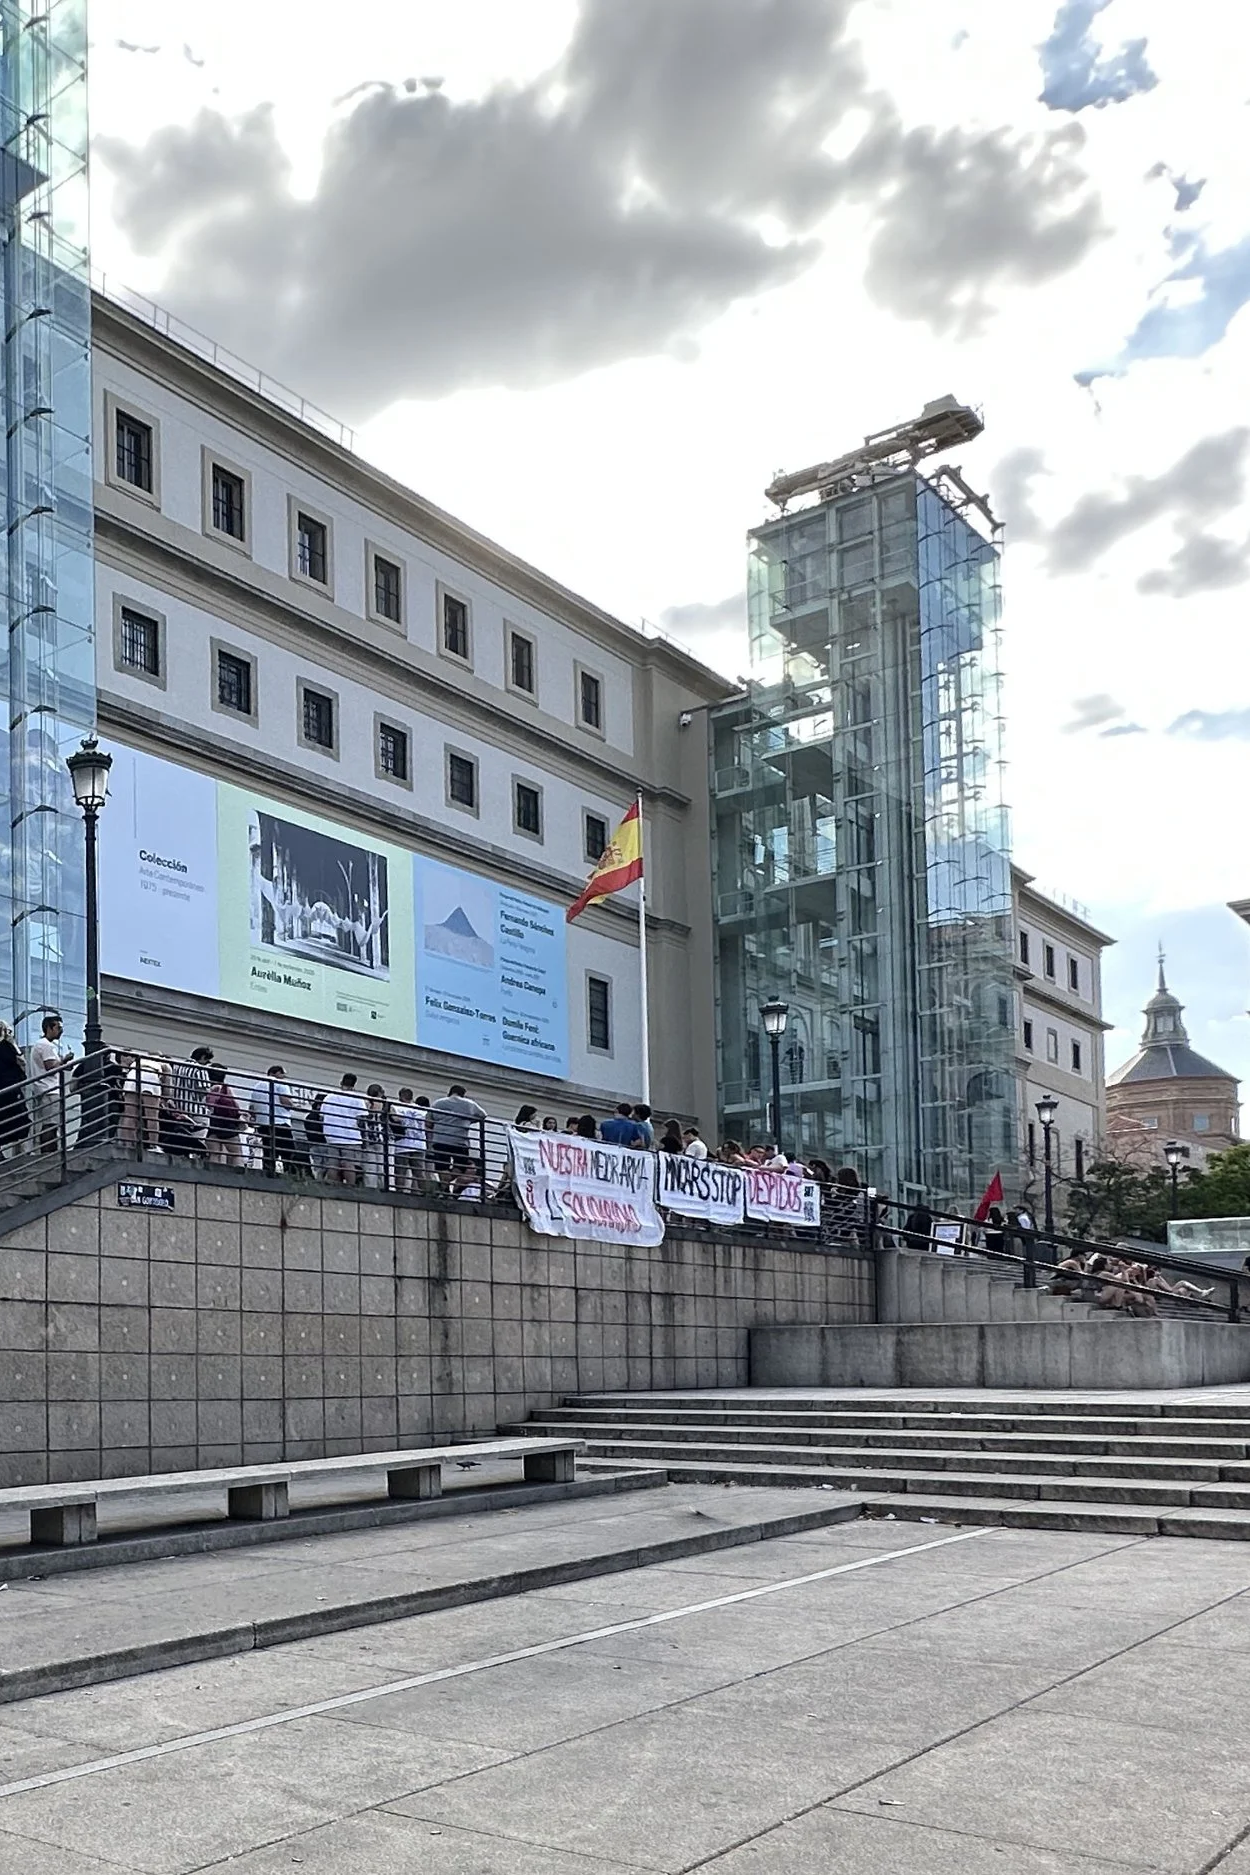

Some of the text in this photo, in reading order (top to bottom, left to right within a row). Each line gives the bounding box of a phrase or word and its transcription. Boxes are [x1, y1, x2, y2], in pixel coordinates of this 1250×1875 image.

[139, 850, 188, 873] Colección
[500, 910, 528, 927] Fernando
[282, 974, 312, 991] Muñoz
[501, 975, 523, 989] Andrea
[539, 1139, 589, 1178] NUESTRA
[619, 1155, 649, 1194] ARMA
[711, 1168, 742, 1207] STOP
[747, 1170, 801, 1212] DESPIDOS
[562, 1191, 642, 1233] SOLIDARIDAD
